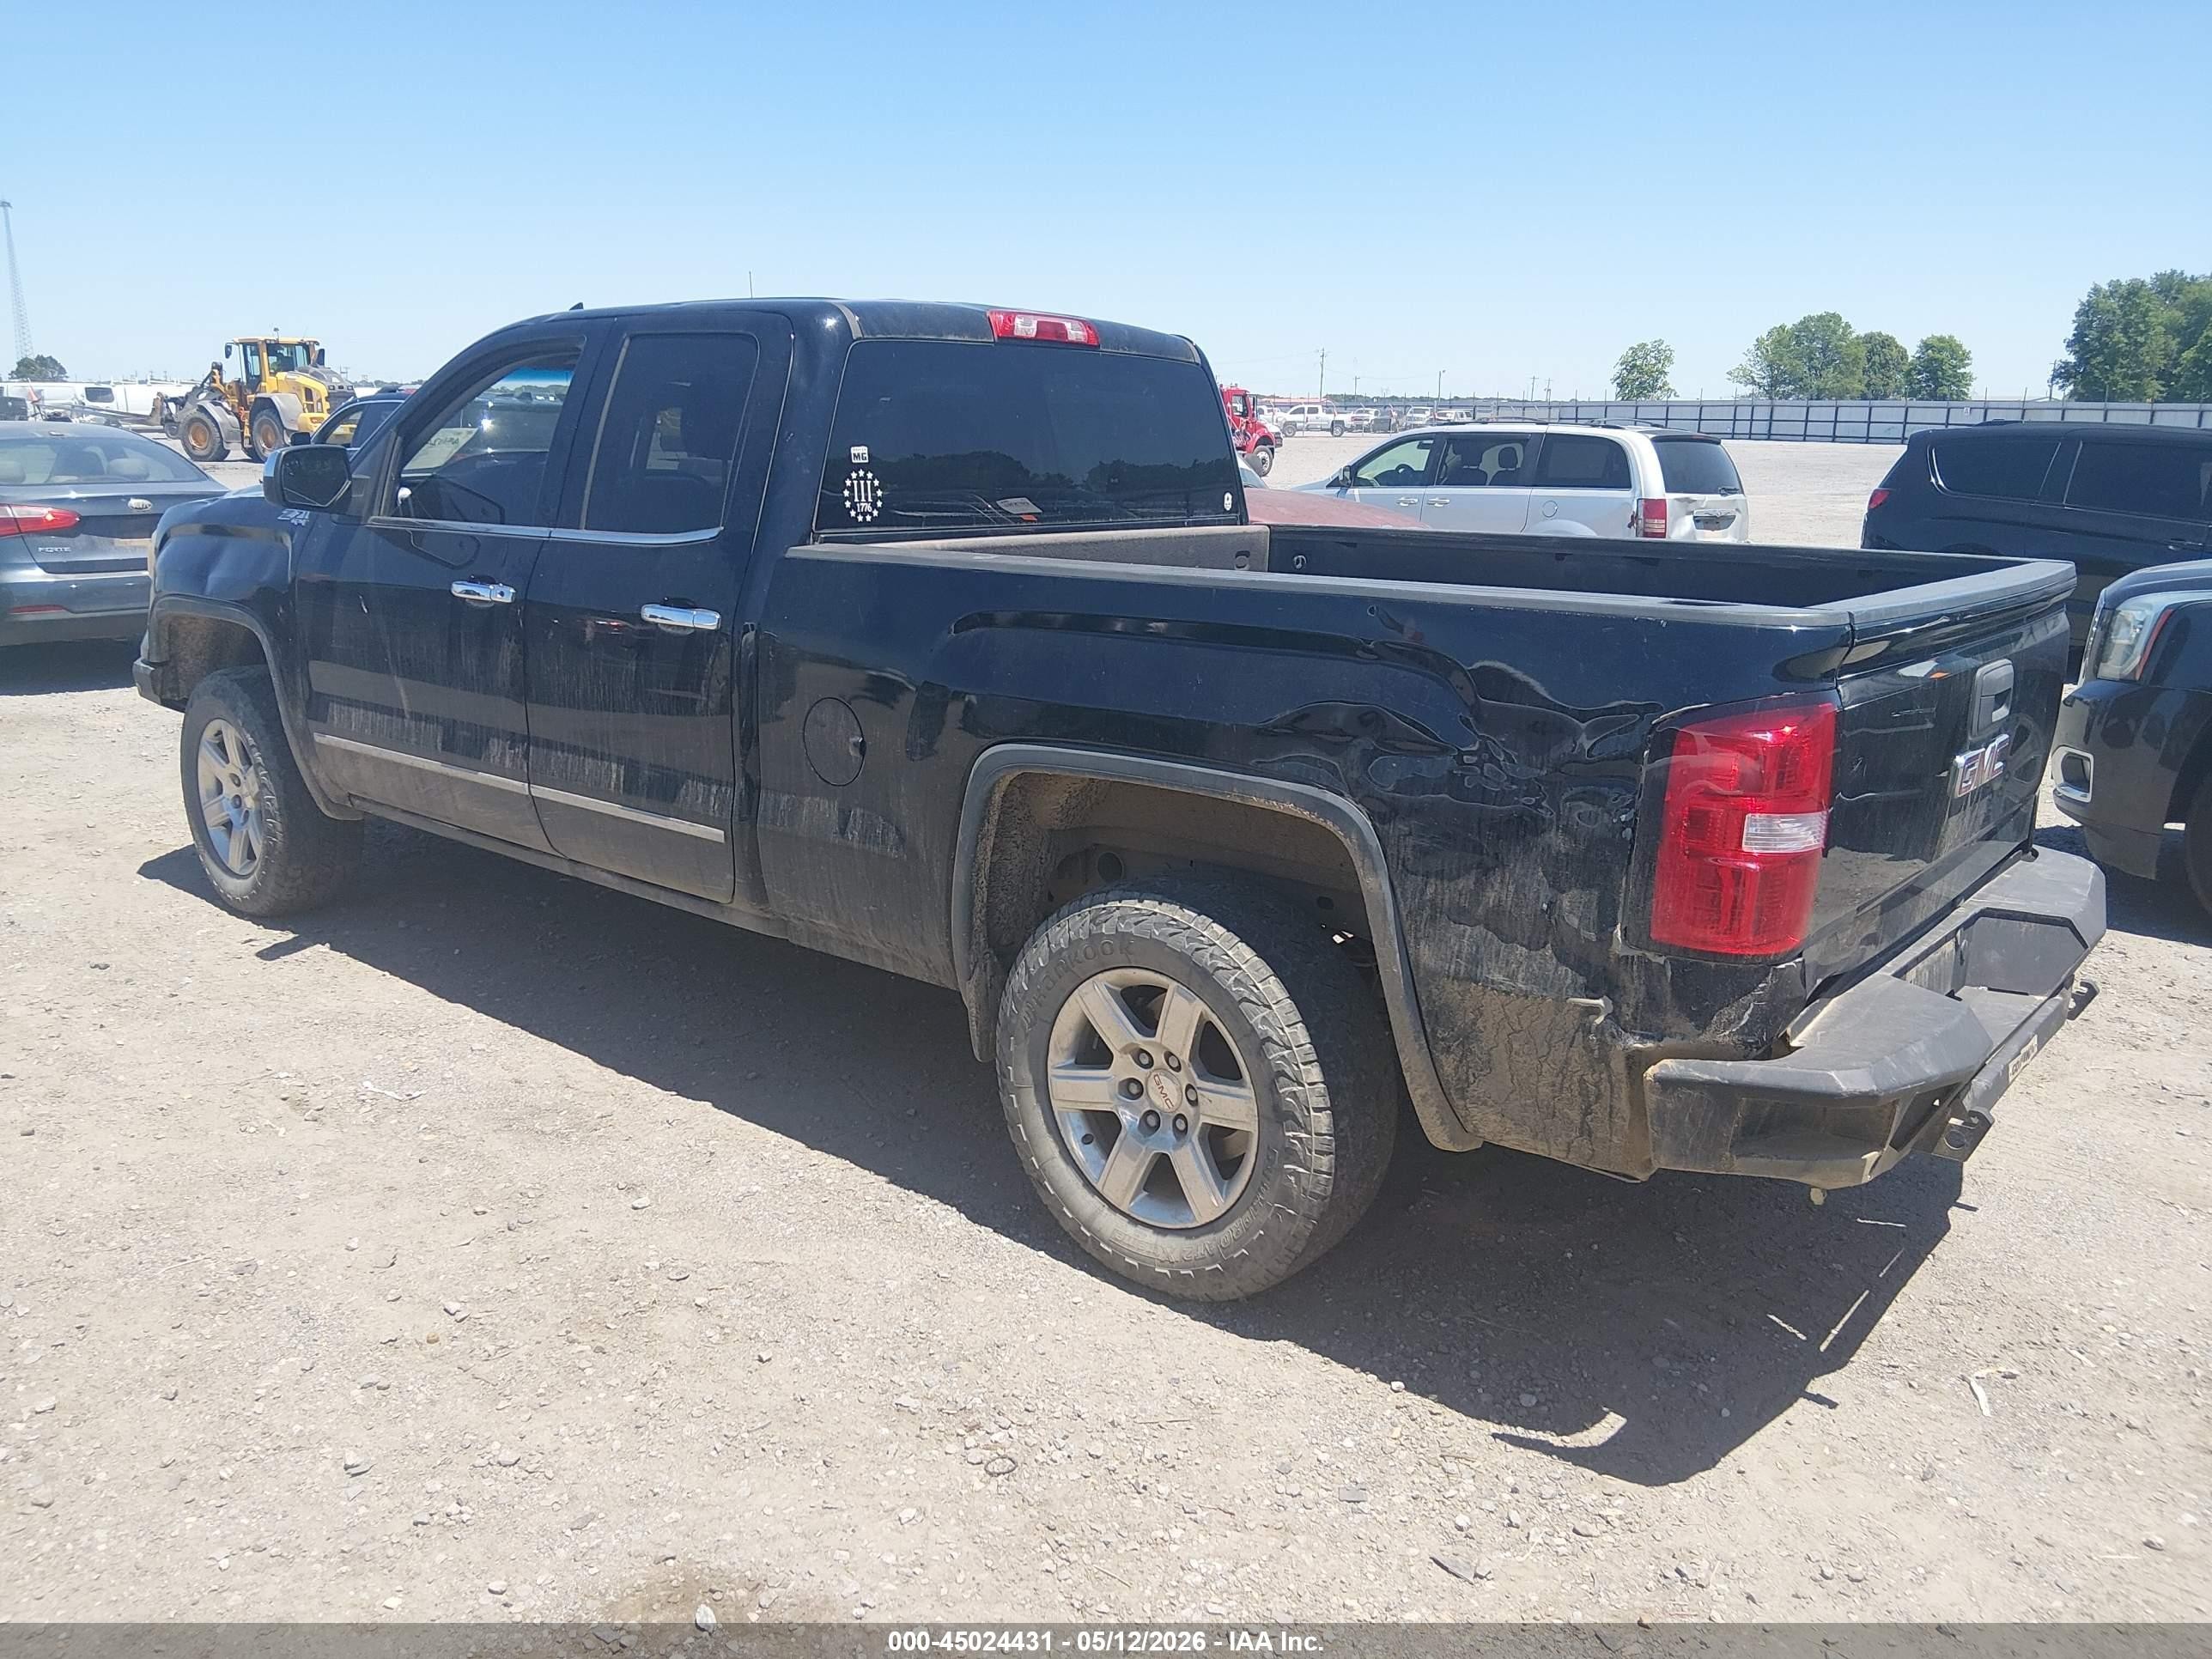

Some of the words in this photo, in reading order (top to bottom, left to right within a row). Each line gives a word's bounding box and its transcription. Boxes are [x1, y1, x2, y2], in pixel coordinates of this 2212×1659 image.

[853, 452, 868, 461] MG
[853, 480, 873, 502] III
[276, 508, 310, 520] Z71
[856, 502, 872, 513] 1776
[1948, 733, 2011, 798] GMC
[1153, 1073, 1174, 1109] GMC
